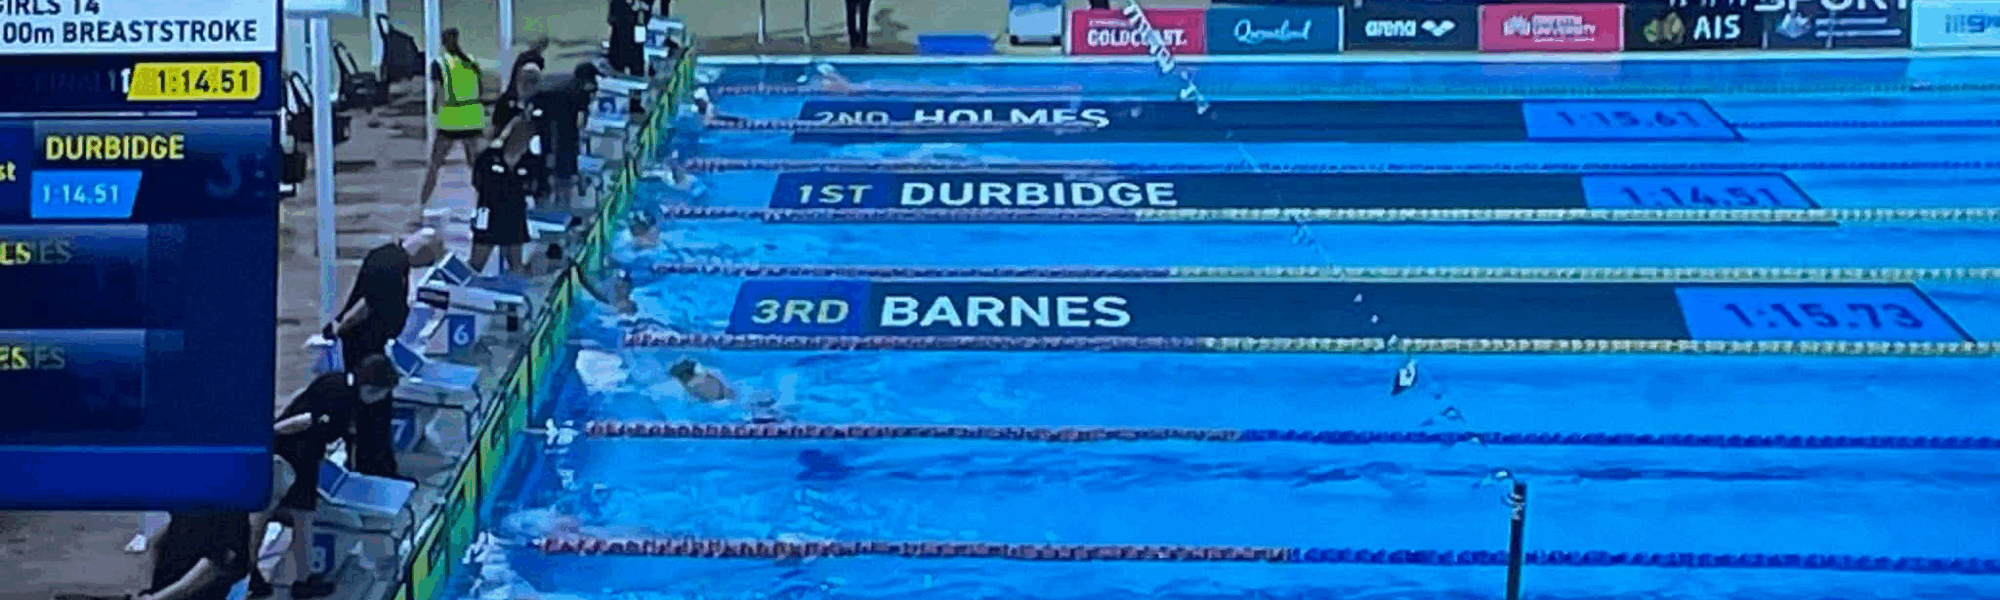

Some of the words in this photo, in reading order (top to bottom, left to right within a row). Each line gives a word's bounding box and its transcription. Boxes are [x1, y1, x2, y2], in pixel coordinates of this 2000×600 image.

[74, 0, 100, 15] 14
[3, 22, 54, 43] 00m
[63, 20, 258, 43] BREASTSTROKE
[1694, 15, 1741, 40] AIS
[158, 69, 249, 94] 1:14.51
[914, 108, 1110, 128] HOLMES
[46, 135, 185, 160] DURBIDGE
[42, 184, 118, 204] 1:14.51
[800, 184, 873, 203] 1ST
[901, 182, 1178, 206] DURBIDGE
[1621, 187, 1783, 208] 1:14.51
[752, 299, 849, 324] 3RD
[880, 296, 1131, 327] BARNES
[1724, 303, 1923, 330] 1:15.73
[453, 324, 469, 345] 6
